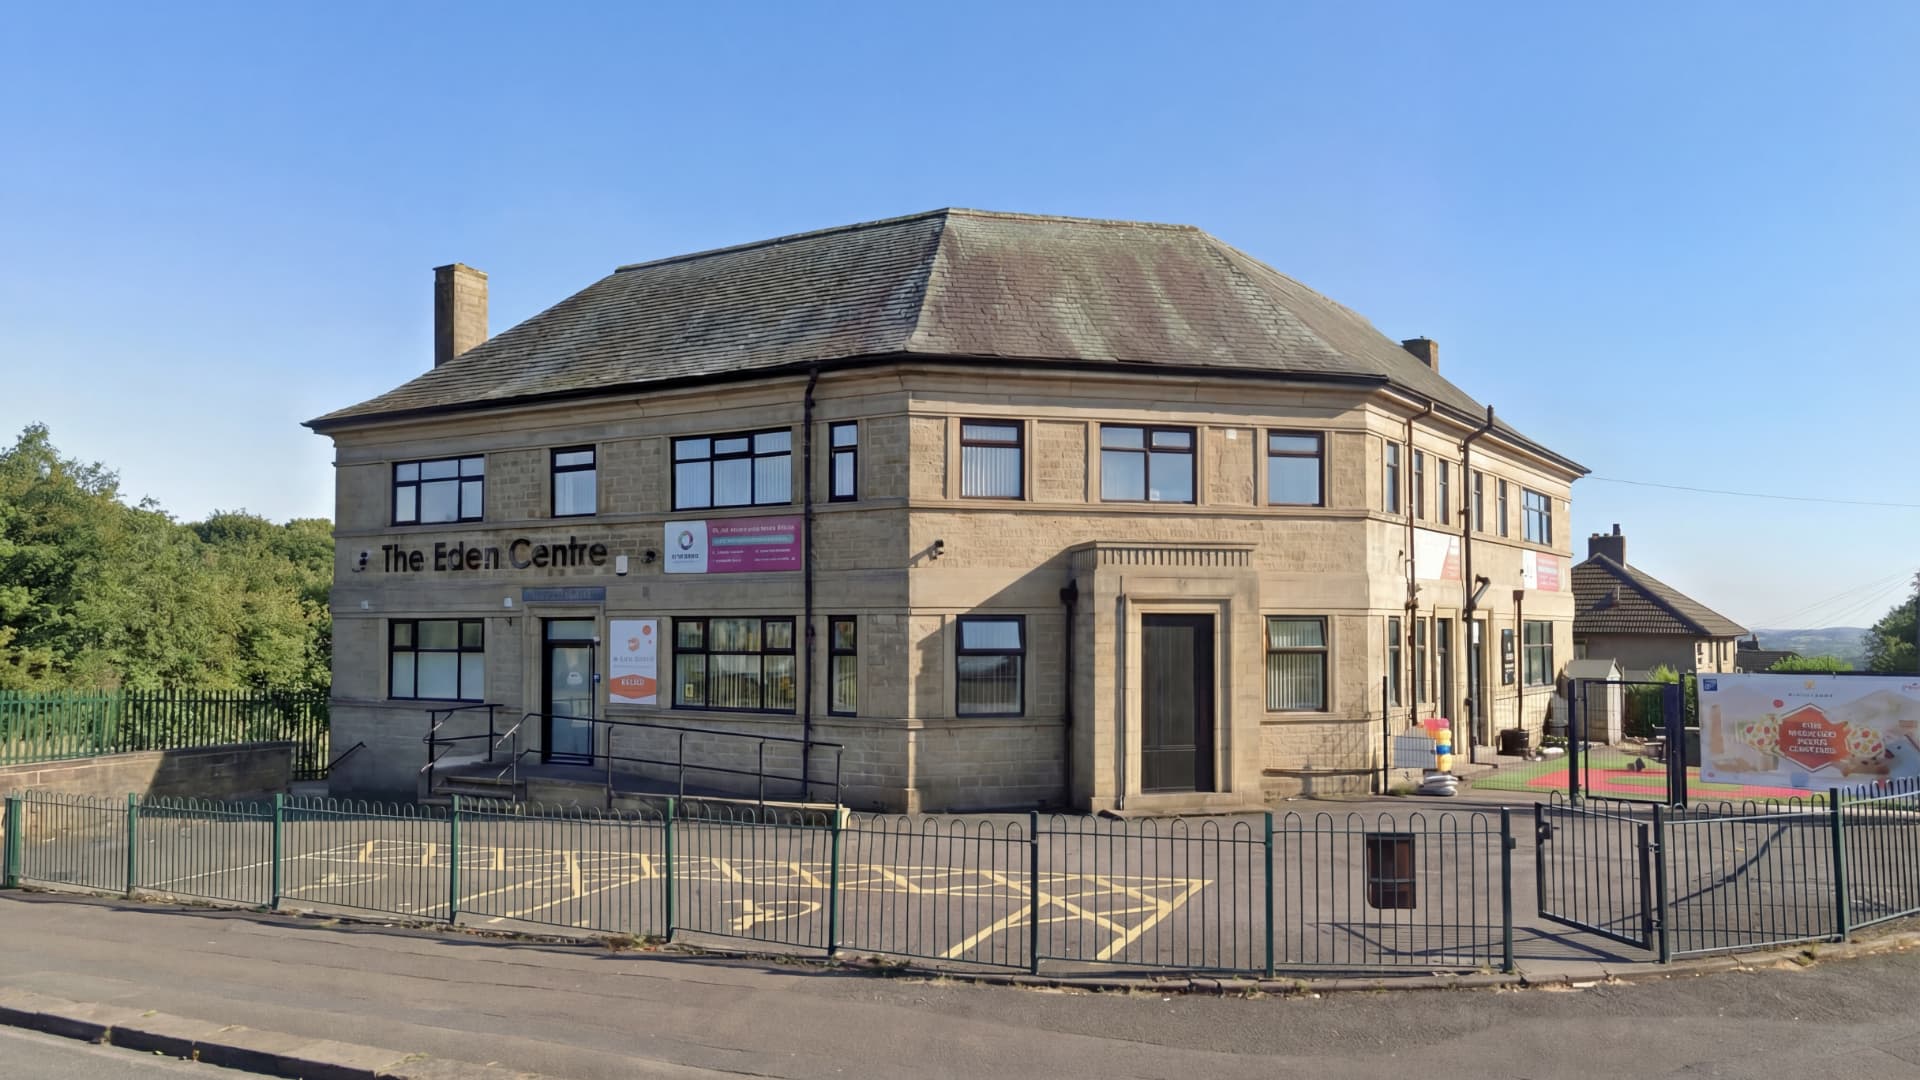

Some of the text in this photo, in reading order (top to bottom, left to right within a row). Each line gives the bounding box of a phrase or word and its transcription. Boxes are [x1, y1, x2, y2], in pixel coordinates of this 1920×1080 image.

[382, 536, 608, 573] The Eden Centre
